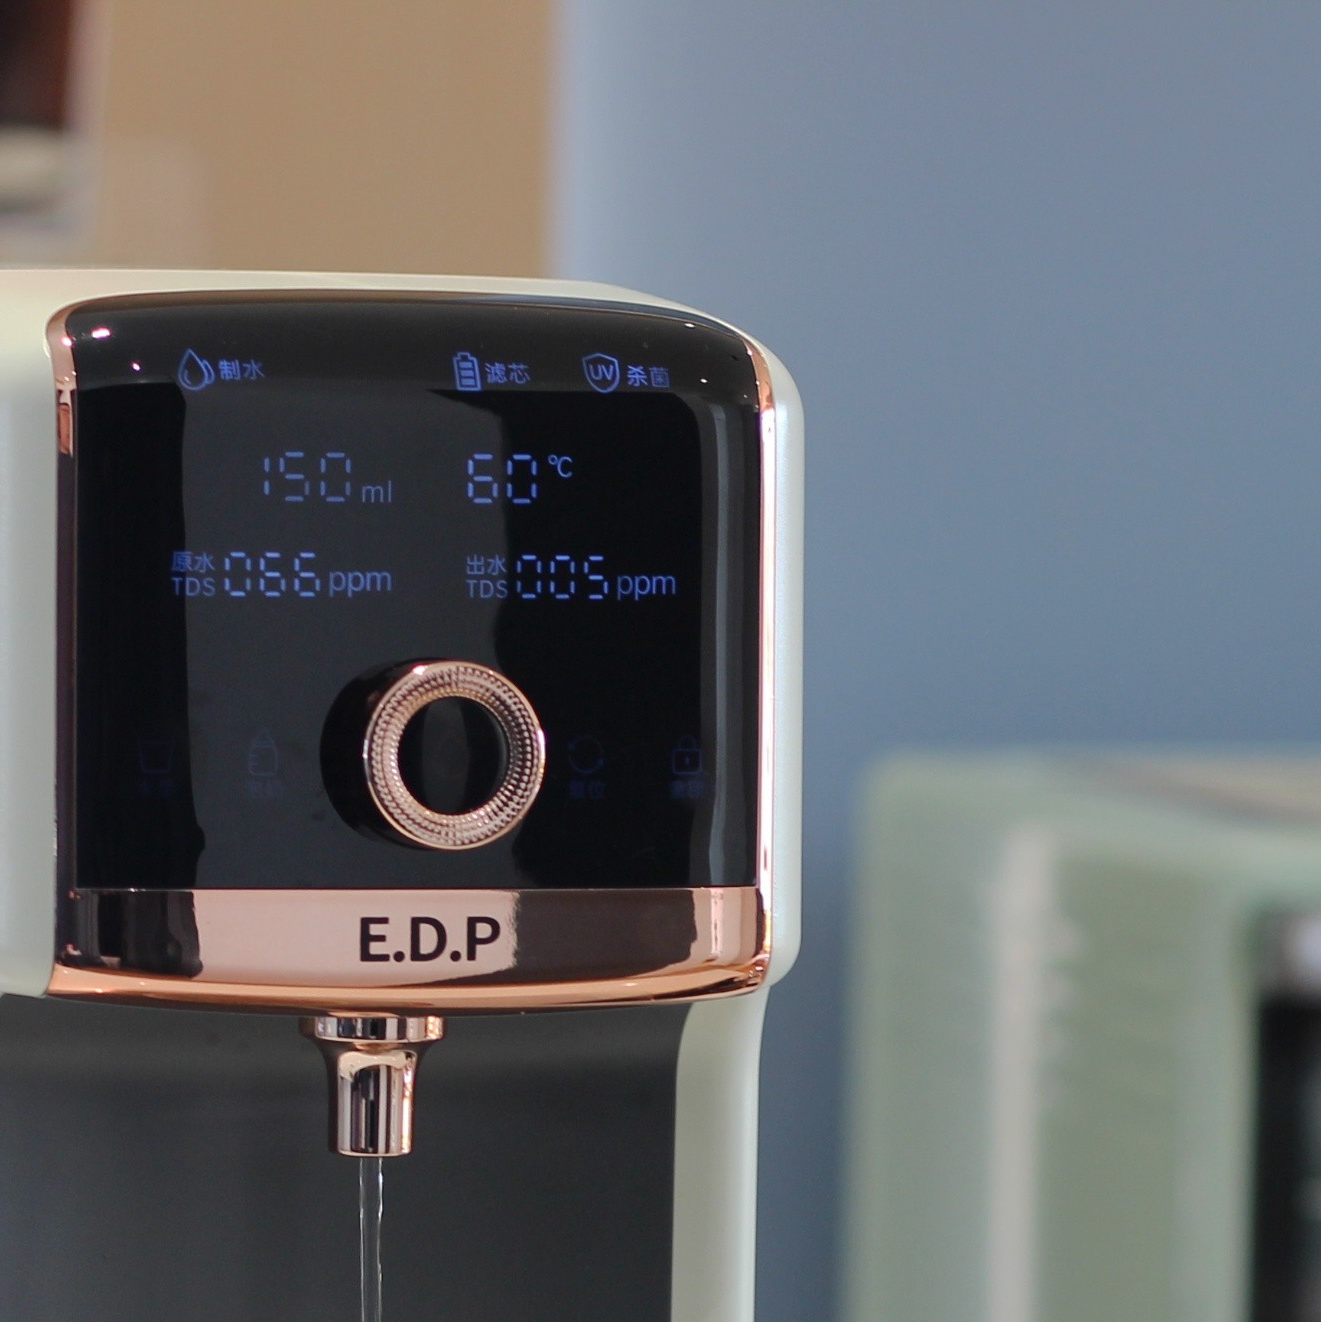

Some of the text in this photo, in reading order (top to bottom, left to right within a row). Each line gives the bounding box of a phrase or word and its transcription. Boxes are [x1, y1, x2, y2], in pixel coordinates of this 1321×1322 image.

[219, 359, 264, 380] 制水
[485, 362, 530, 384] 滤芯
[590, 364, 614, 380] UV
[627, 366, 670, 388] 杀菌
[264, 452, 391, 502] 150 ml
[467, 453, 537, 503] 60
[172, 552, 215, 572] 原水
[466, 554, 507, 575] 出水
[172, 552, 392, 598] TDS 066 ppm
[466, 555, 676, 600] TDS 005 ppm
[359, 916, 501, 962] E.D.P
